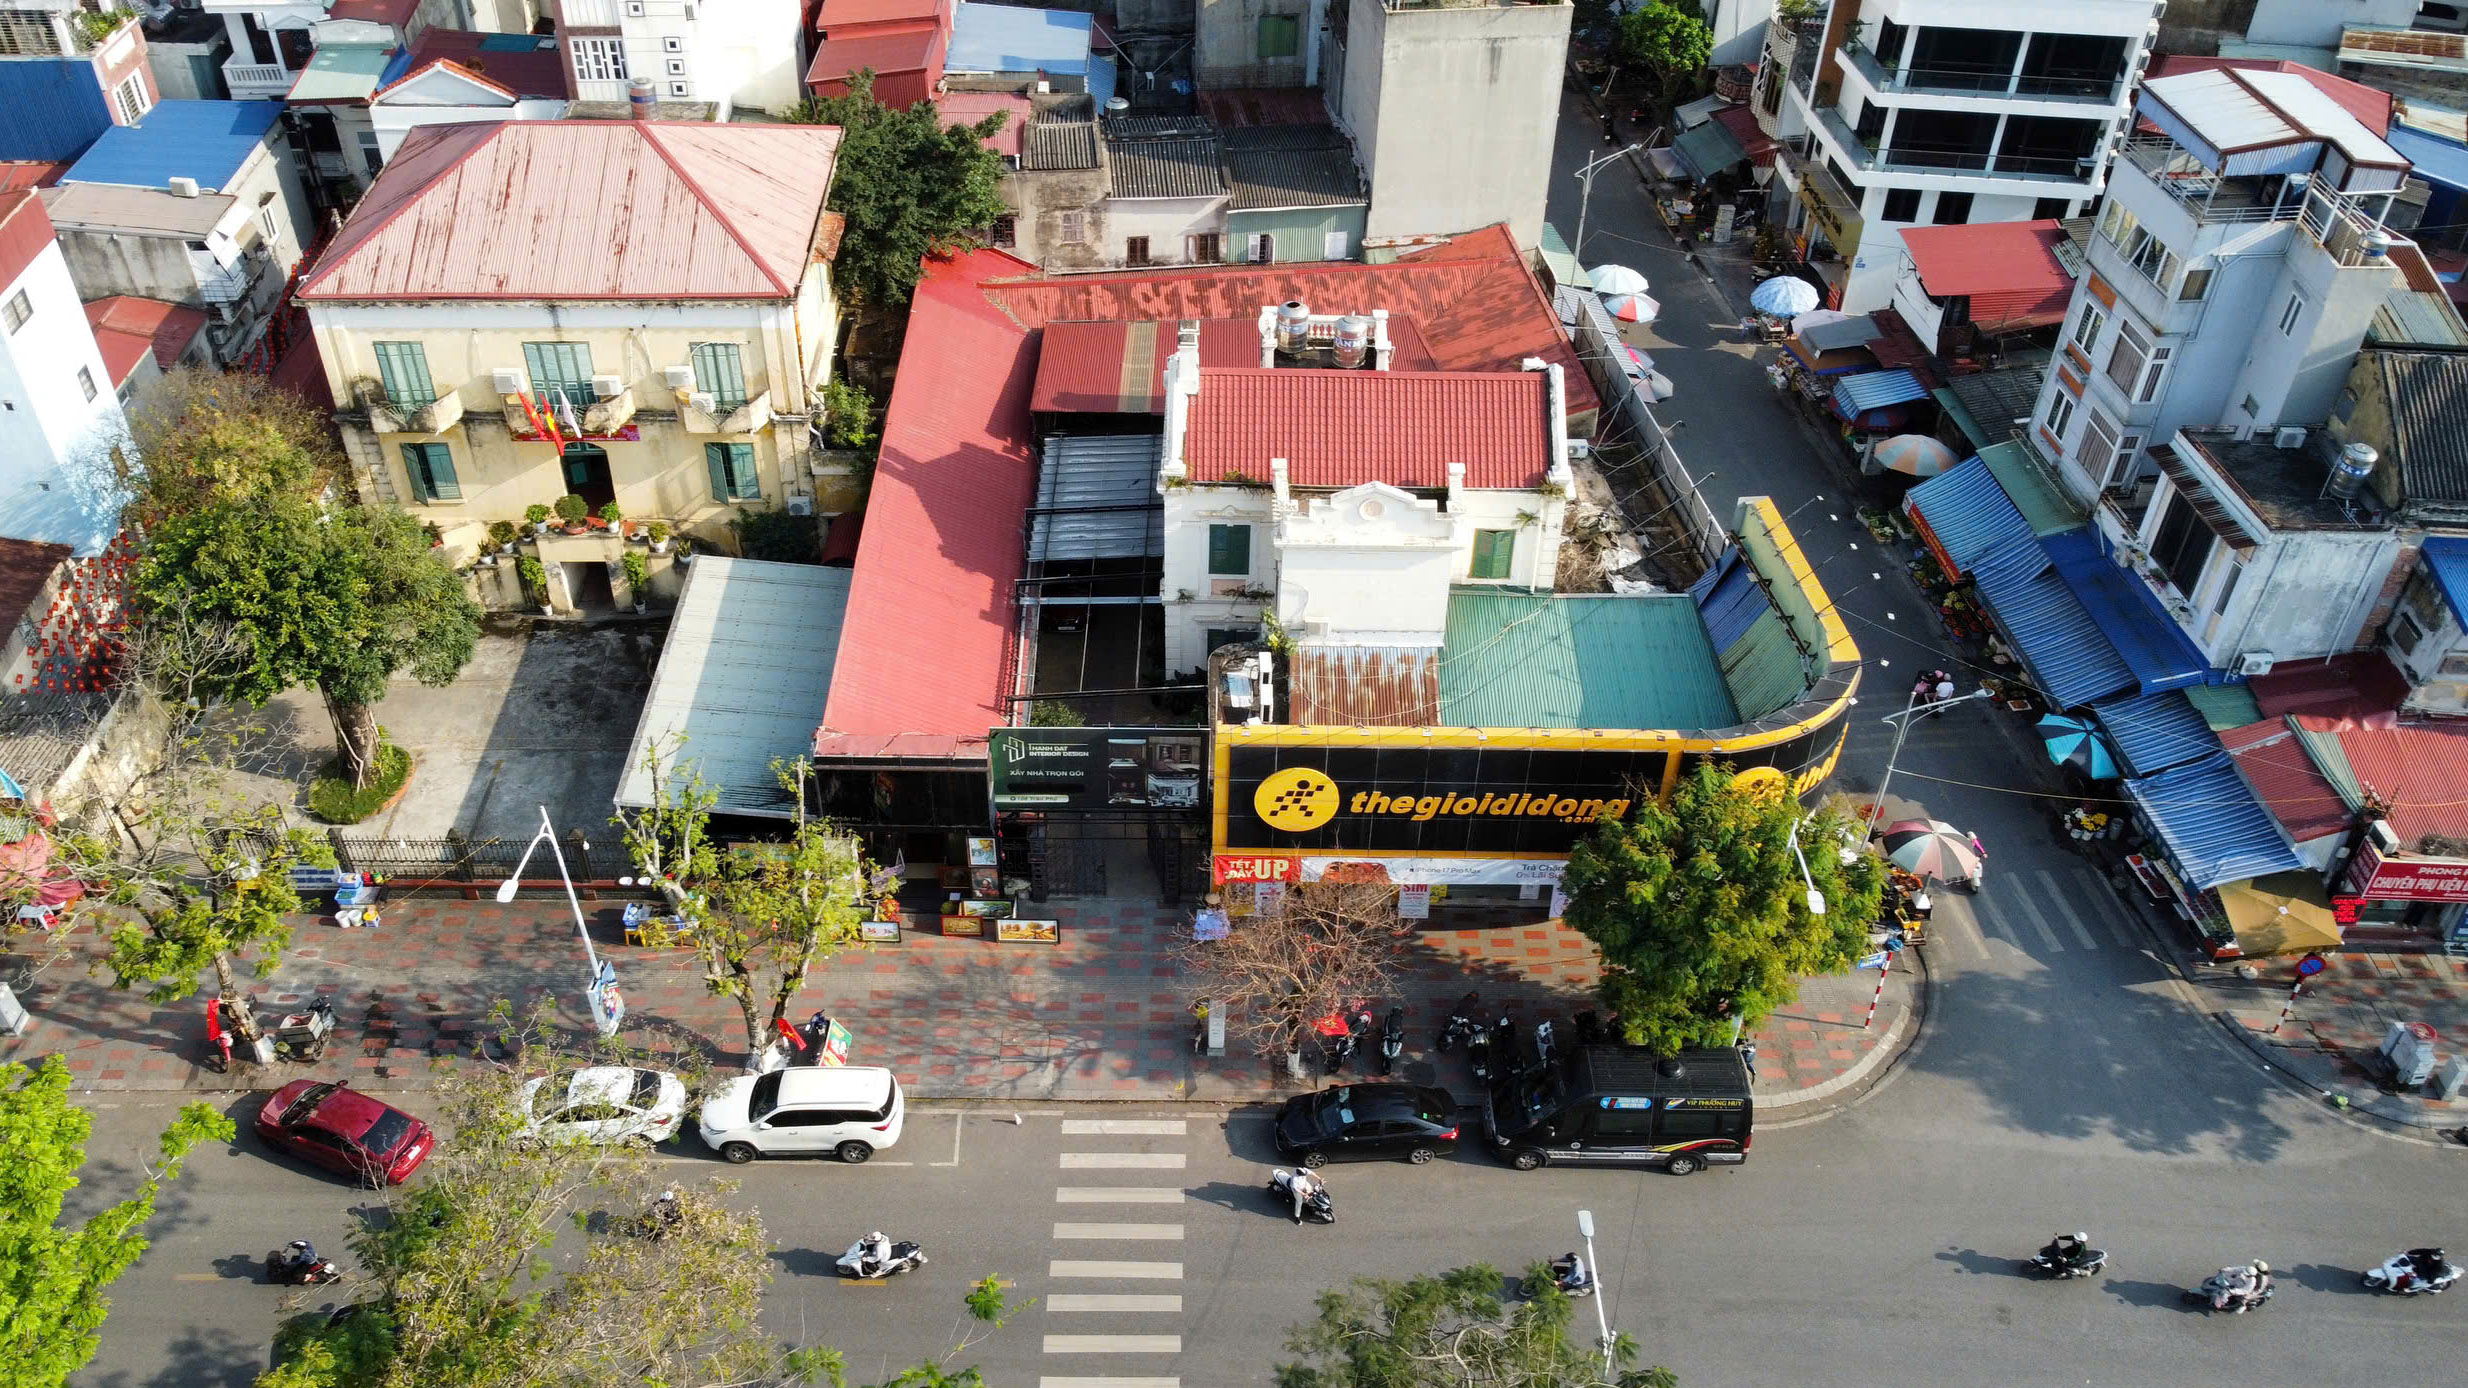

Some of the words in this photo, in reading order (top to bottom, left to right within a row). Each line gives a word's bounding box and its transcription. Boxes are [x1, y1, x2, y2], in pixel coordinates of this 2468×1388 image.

[1350, 791, 1630, 821] thegioididong
[1255, 859, 1290, 880] UP
[2418, 867, 2461, 876] PHONG
